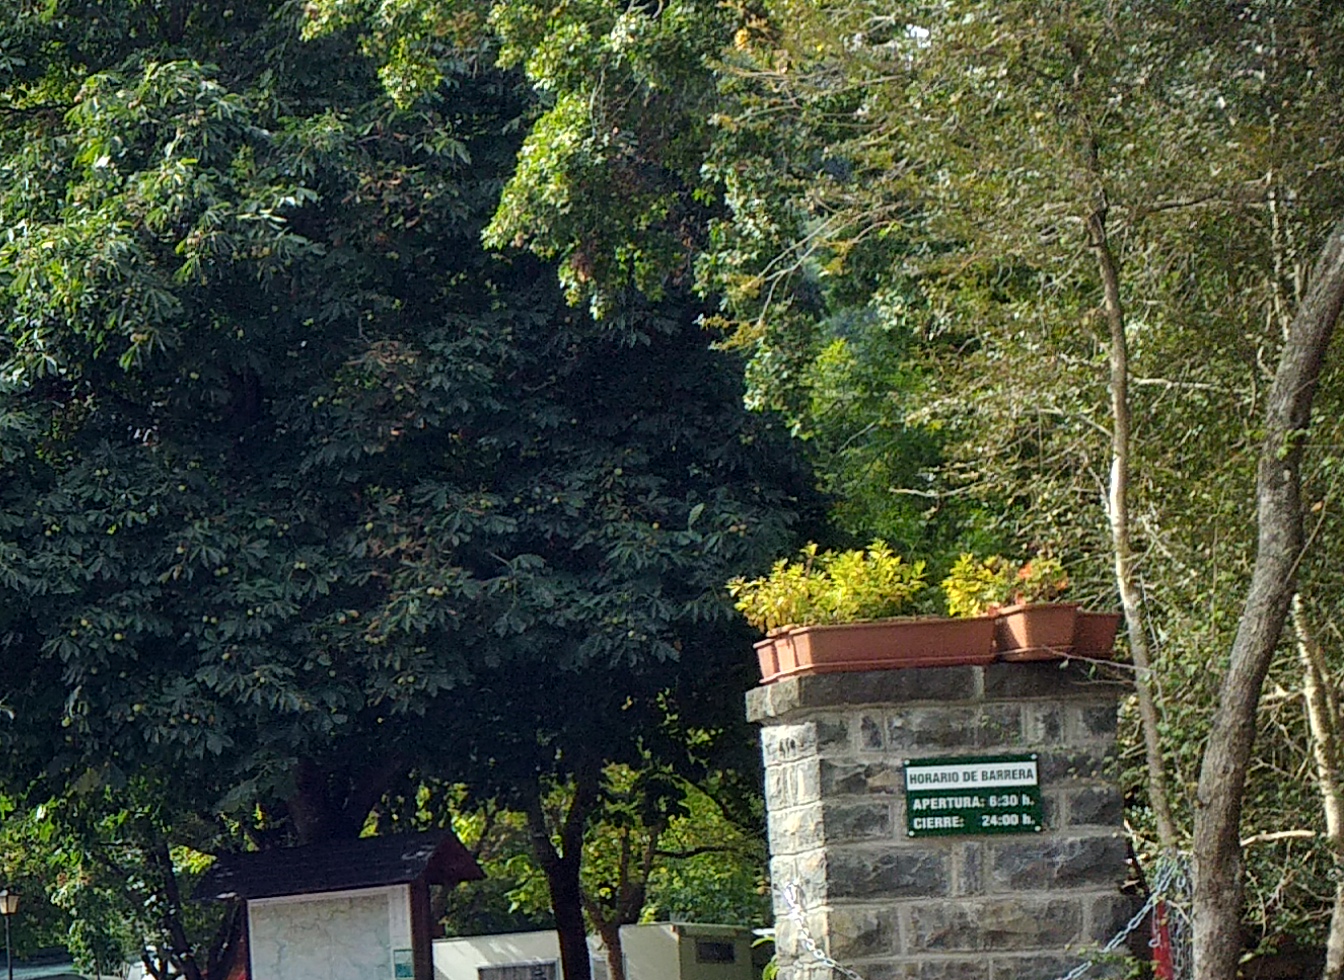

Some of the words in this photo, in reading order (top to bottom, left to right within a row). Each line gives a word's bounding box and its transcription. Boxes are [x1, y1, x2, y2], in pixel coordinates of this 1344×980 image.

[909, 771, 960, 784] HORARIO
[963, 771, 979, 782] DE
[981, 768, 1034, 782] BARRERA
[913, 796, 985, 811] APERTURA:
[989, 795, 1019, 807] 6:30
[913, 815, 965, 829] CIERRE:
[981, 814, 1019, 827] 24:00
